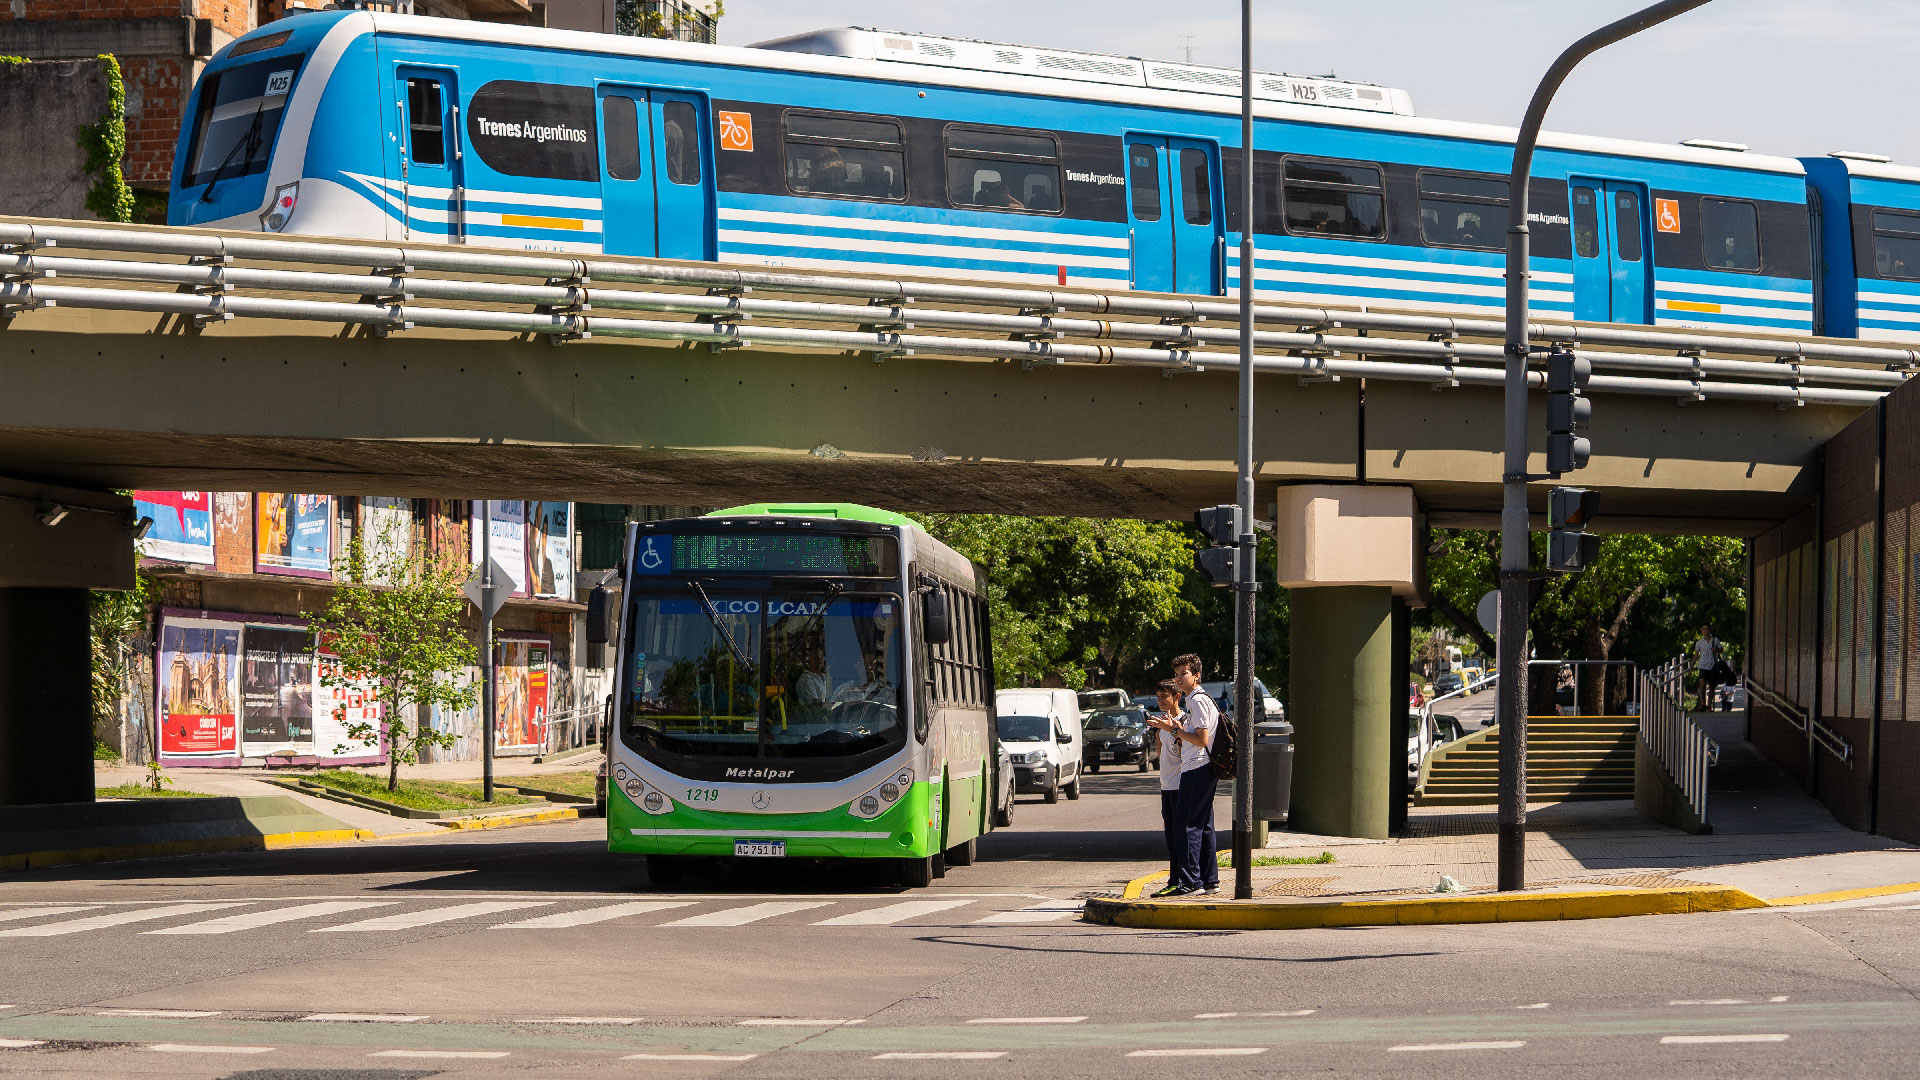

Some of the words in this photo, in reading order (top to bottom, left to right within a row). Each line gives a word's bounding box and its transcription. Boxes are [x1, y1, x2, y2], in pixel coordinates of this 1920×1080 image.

[269, 77, 289, 92] M25
[1292, 84, 1317, 101] M25
[478, 117, 522, 138] Trenes
[523, 121, 587, 143] Argentinos
[1065, 169, 1090, 182] Trenes
[1090, 171, 1125, 186] Argentinos
[1540, 211, 1569, 225] Argentinos
[674, 536, 719, 569] 114
[771, 538, 799, 551] LA
[725, 767, 794, 779] Metalpar
[686, 788, 719, 802] 1219
[737, 845, 749, 855] AC
[751, 845, 769, 855] 751
